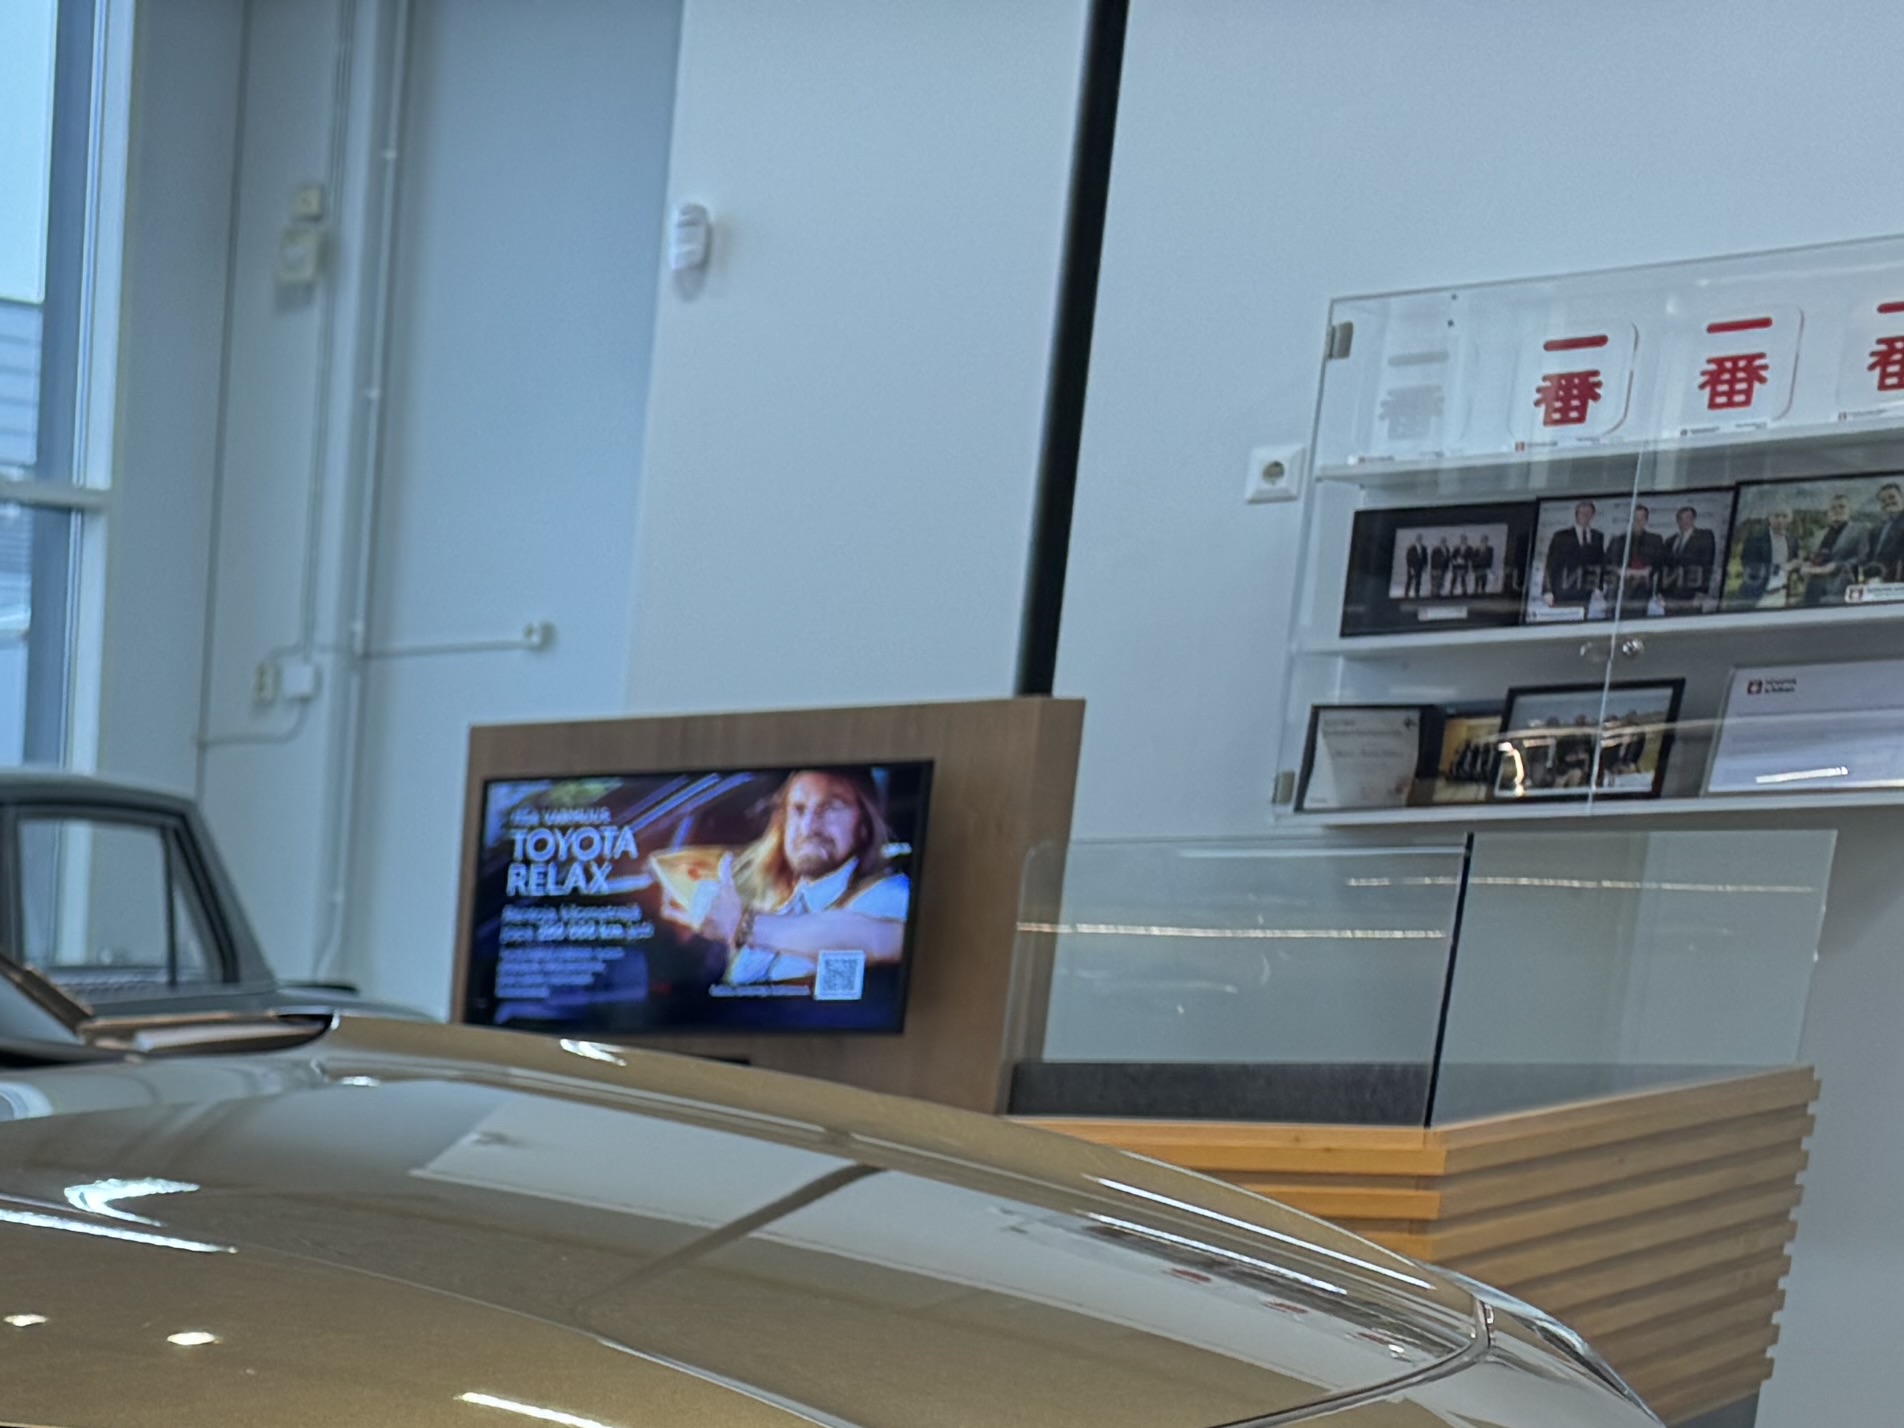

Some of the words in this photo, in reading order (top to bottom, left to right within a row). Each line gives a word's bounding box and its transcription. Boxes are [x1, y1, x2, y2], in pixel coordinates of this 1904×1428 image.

[1533, 334, 1609, 427] 一番
[1697, 317, 1774, 411] 一番
[510, 825, 639, 862] TOYOTA
[506, 861, 613, 897] RELAX
